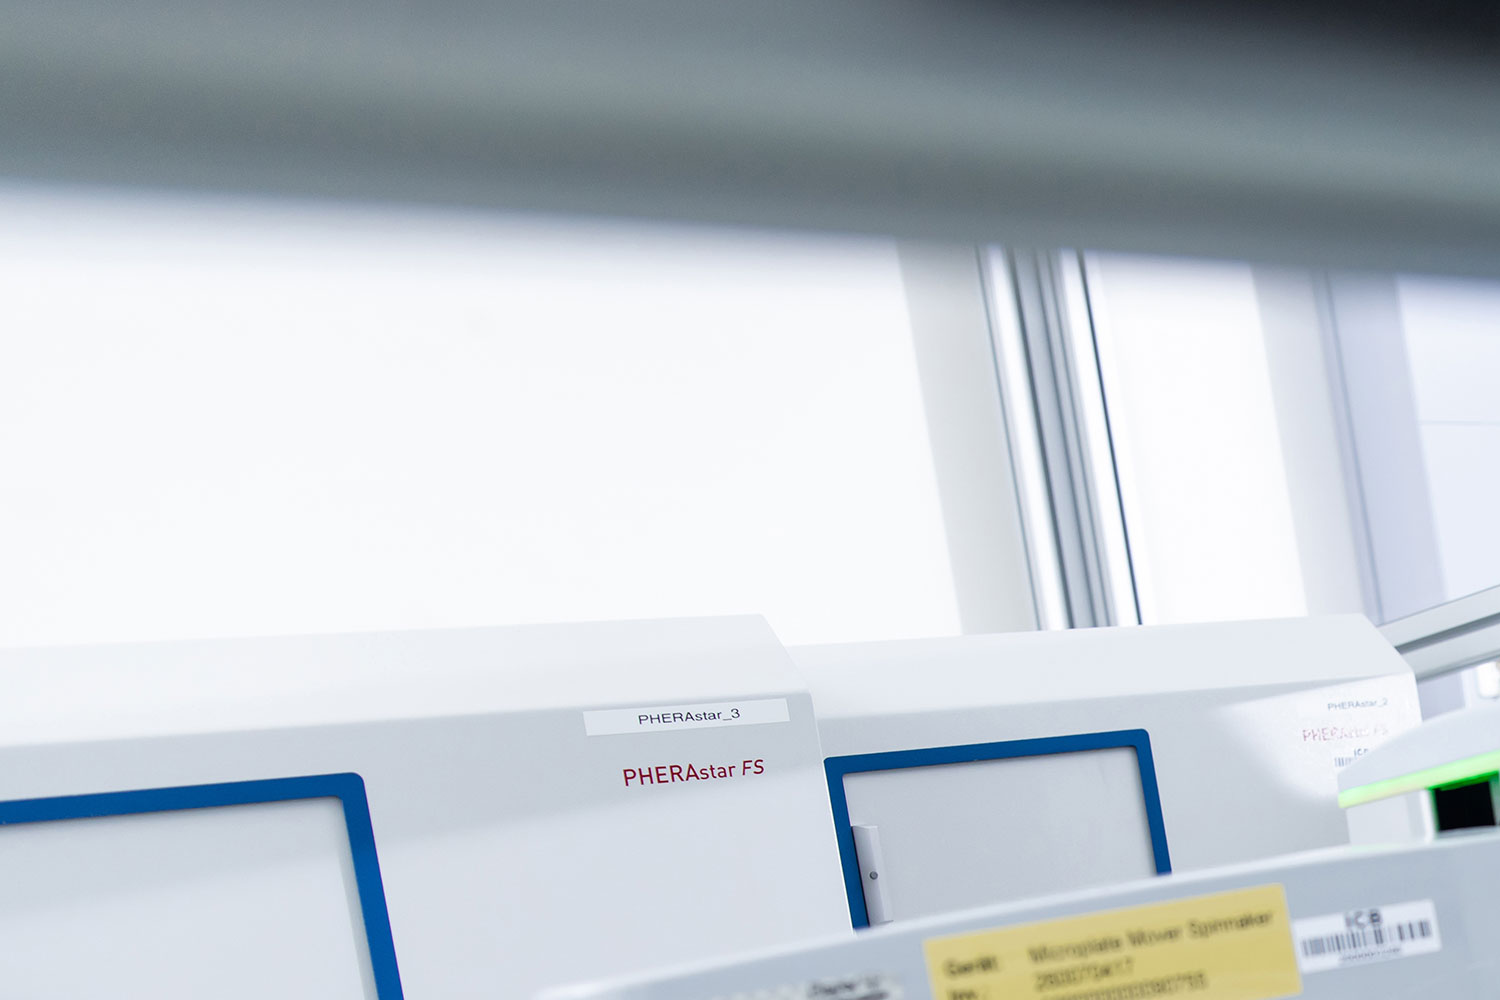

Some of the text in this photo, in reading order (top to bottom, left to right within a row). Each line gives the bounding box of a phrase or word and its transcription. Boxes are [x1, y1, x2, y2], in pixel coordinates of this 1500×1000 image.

[638, 708, 741, 725] PHERAstar_3
[623, 759, 765, 787] PHERAstar FS
